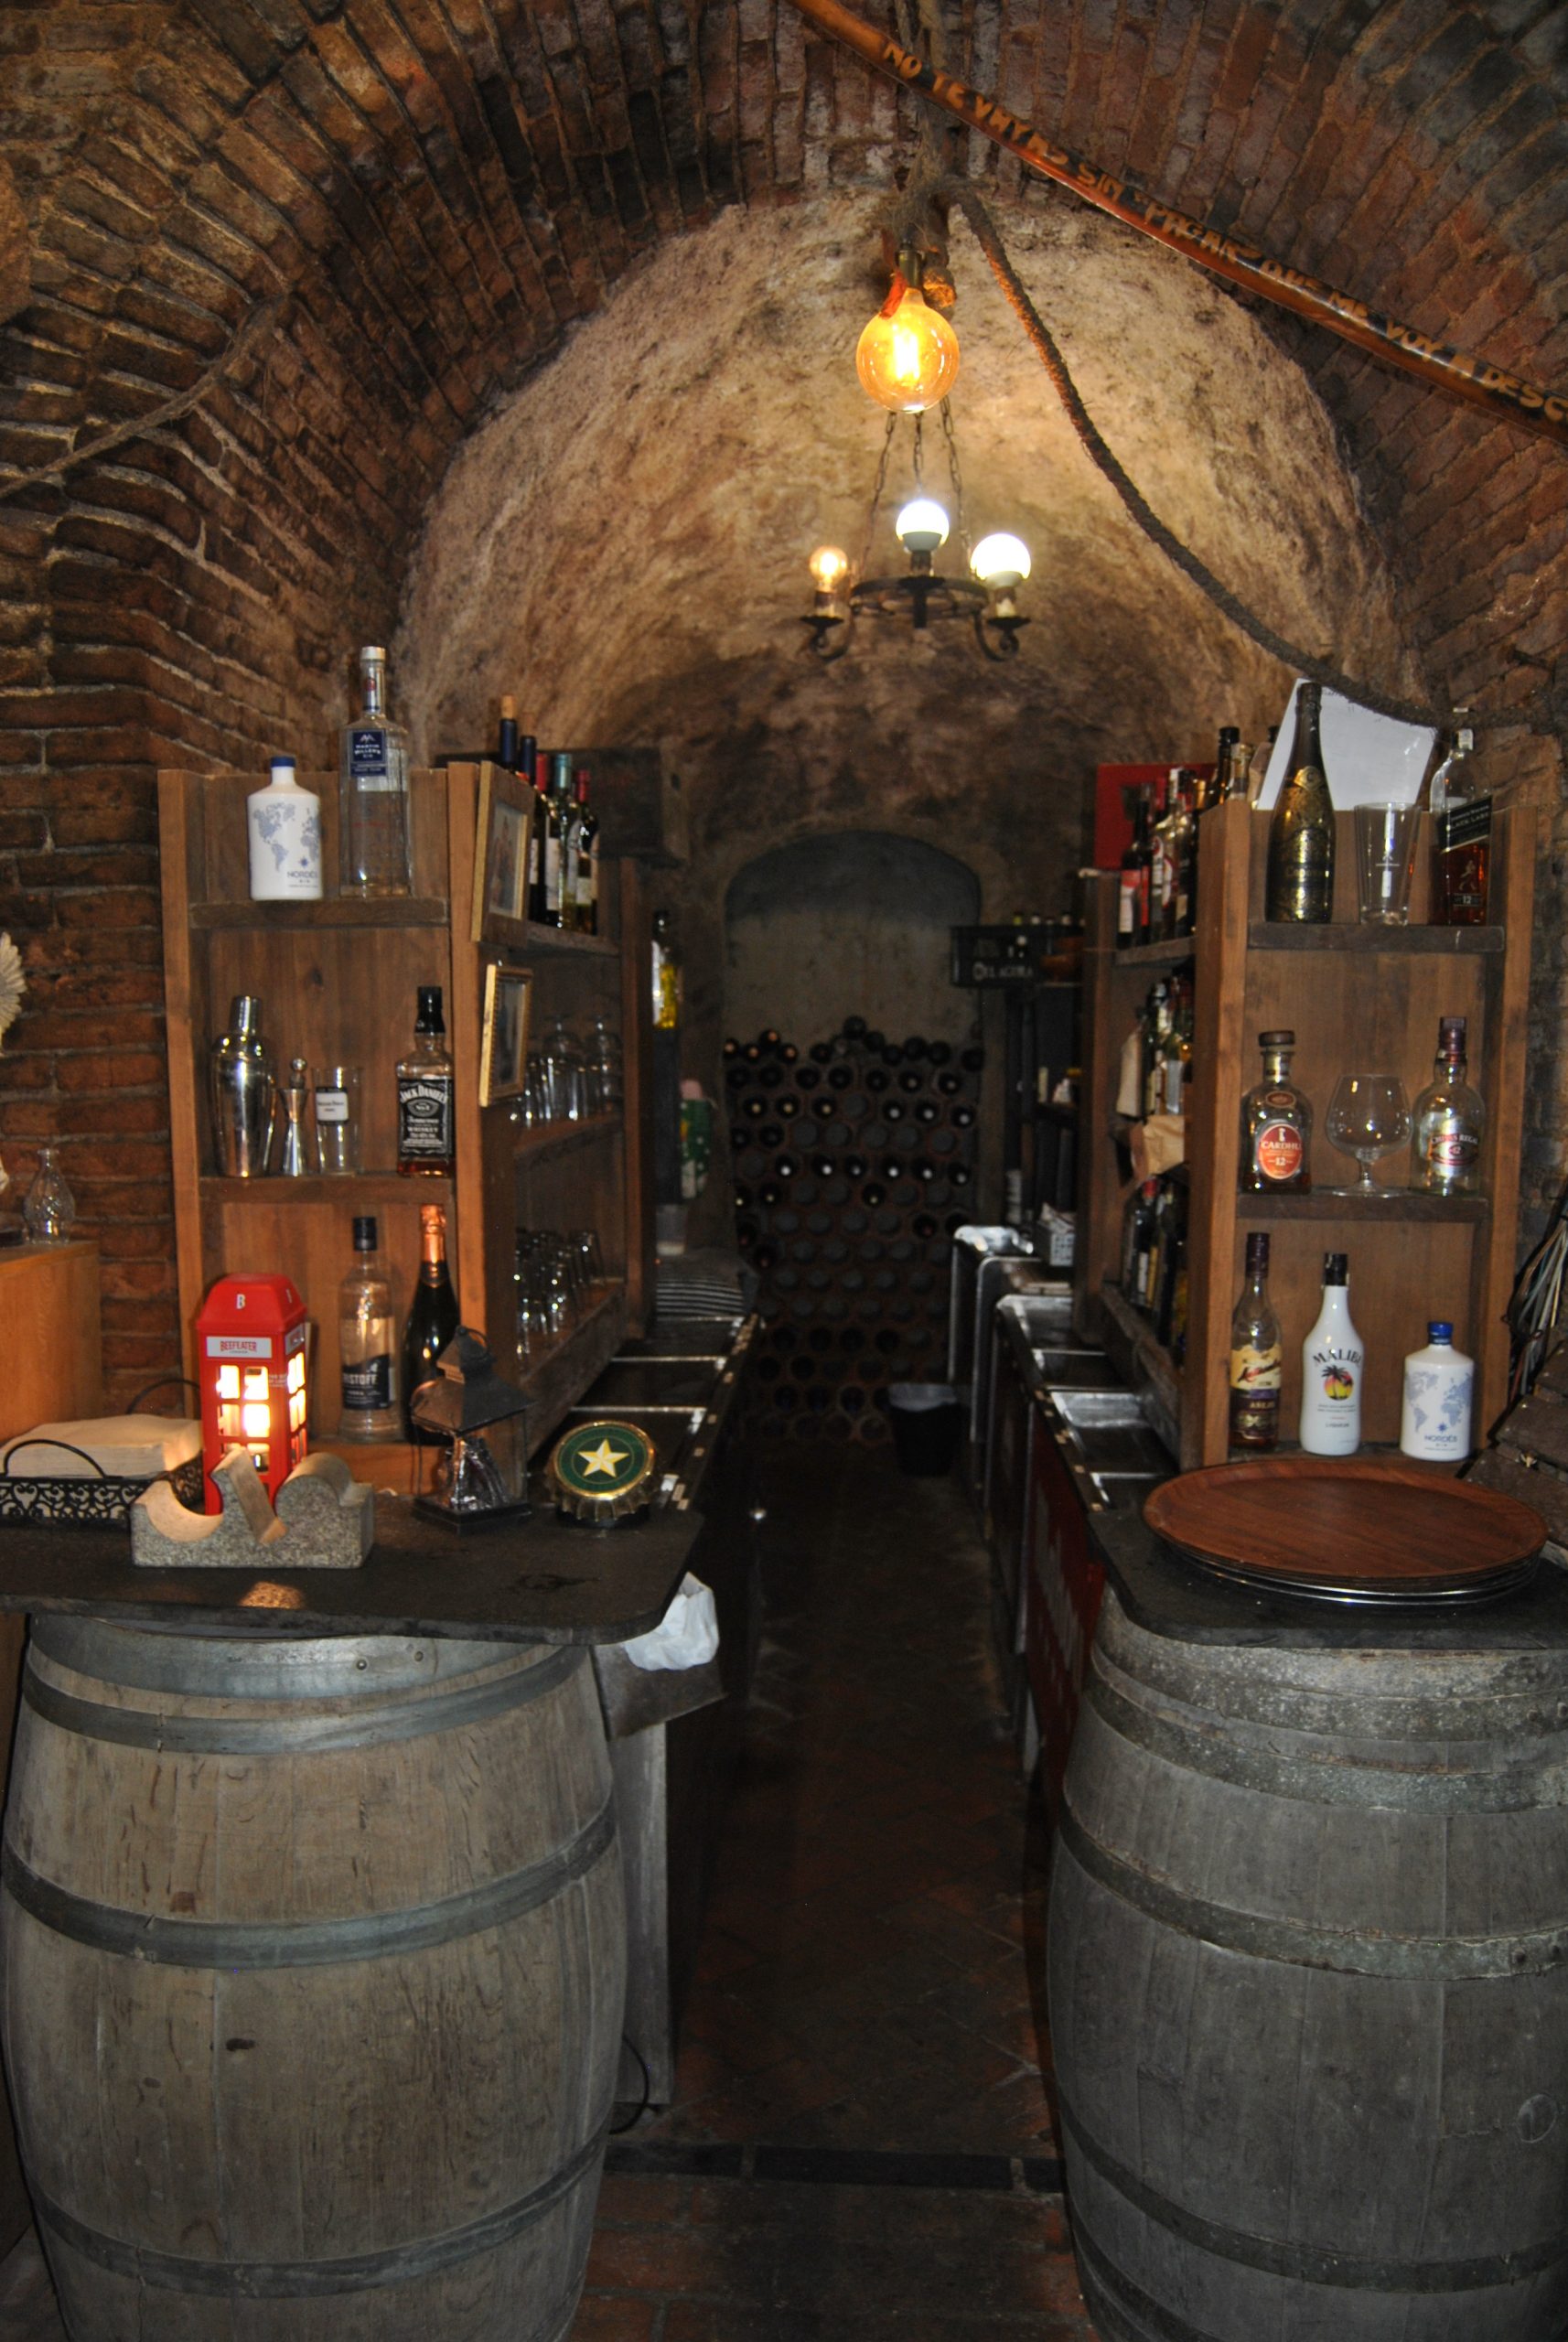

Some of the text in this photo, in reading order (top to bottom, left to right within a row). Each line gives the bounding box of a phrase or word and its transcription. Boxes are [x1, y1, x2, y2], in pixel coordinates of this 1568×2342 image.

[882, 44, 922, 80] NO
[932, 70, 965, 109] TE
[1077, 163, 1124, 203] SIN
[1386, 321, 1445, 360] VOY
[1482, 368, 1568, 421] DESC
[399, 1088, 418, 1103] JACK
[1276, 1156, 1286, 1166] 12
[236, 1292, 246, 1309] B
[220, 1340, 257, 1352] BEEFEATER
